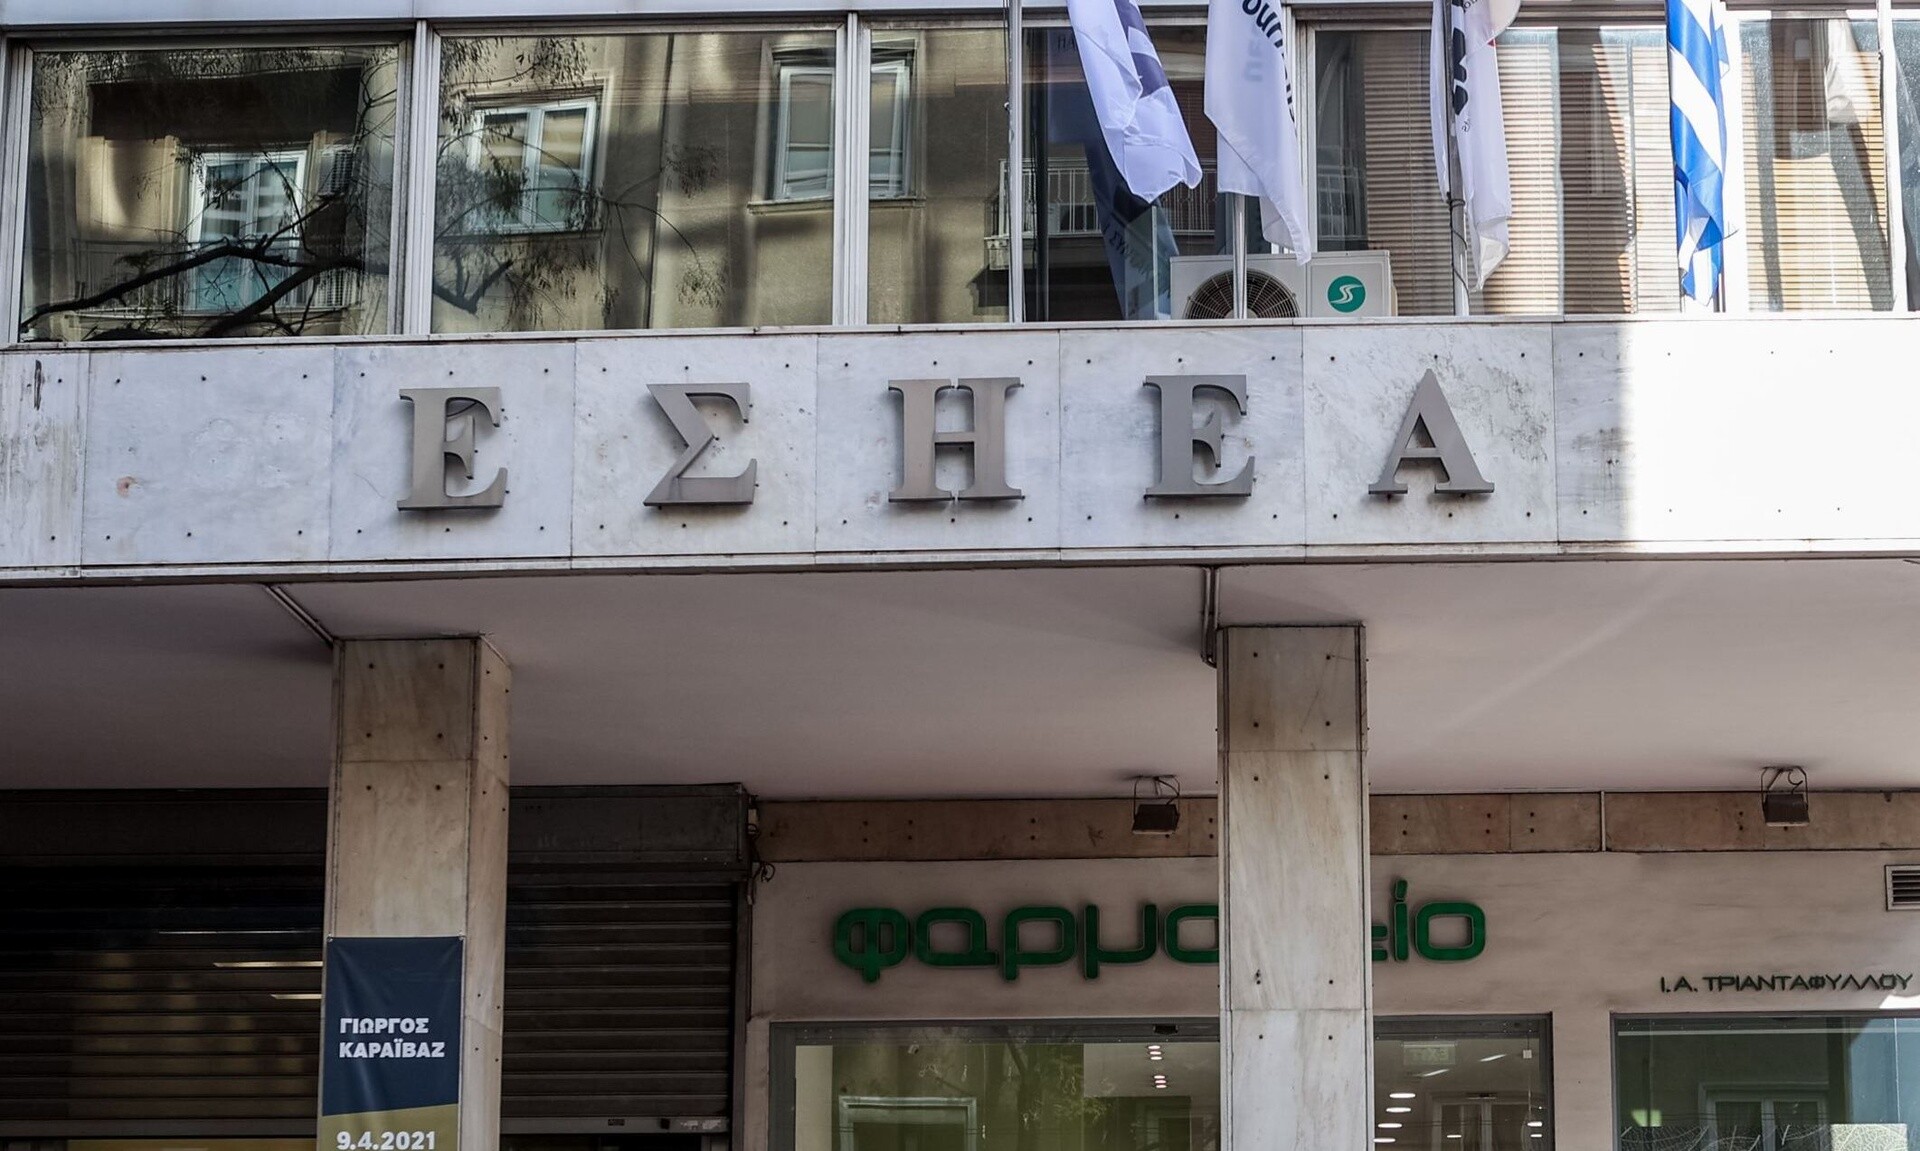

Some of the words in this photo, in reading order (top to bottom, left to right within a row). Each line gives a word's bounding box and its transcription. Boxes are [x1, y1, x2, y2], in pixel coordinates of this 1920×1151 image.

[397, 367, 1495, 511] ΕΣΗΕΑ
[1702, 974, 1913, 991] ΤΡΙΑΝΤΑΦΥΛΛΟΥ
[340, 1018, 429, 1034] ΓΙΩΡΓΟΣ
[339, 1039, 445, 1058] ΚΑΡΑΪΒΑΖ
[337, 1131, 436, 1150] 9.4.2021
